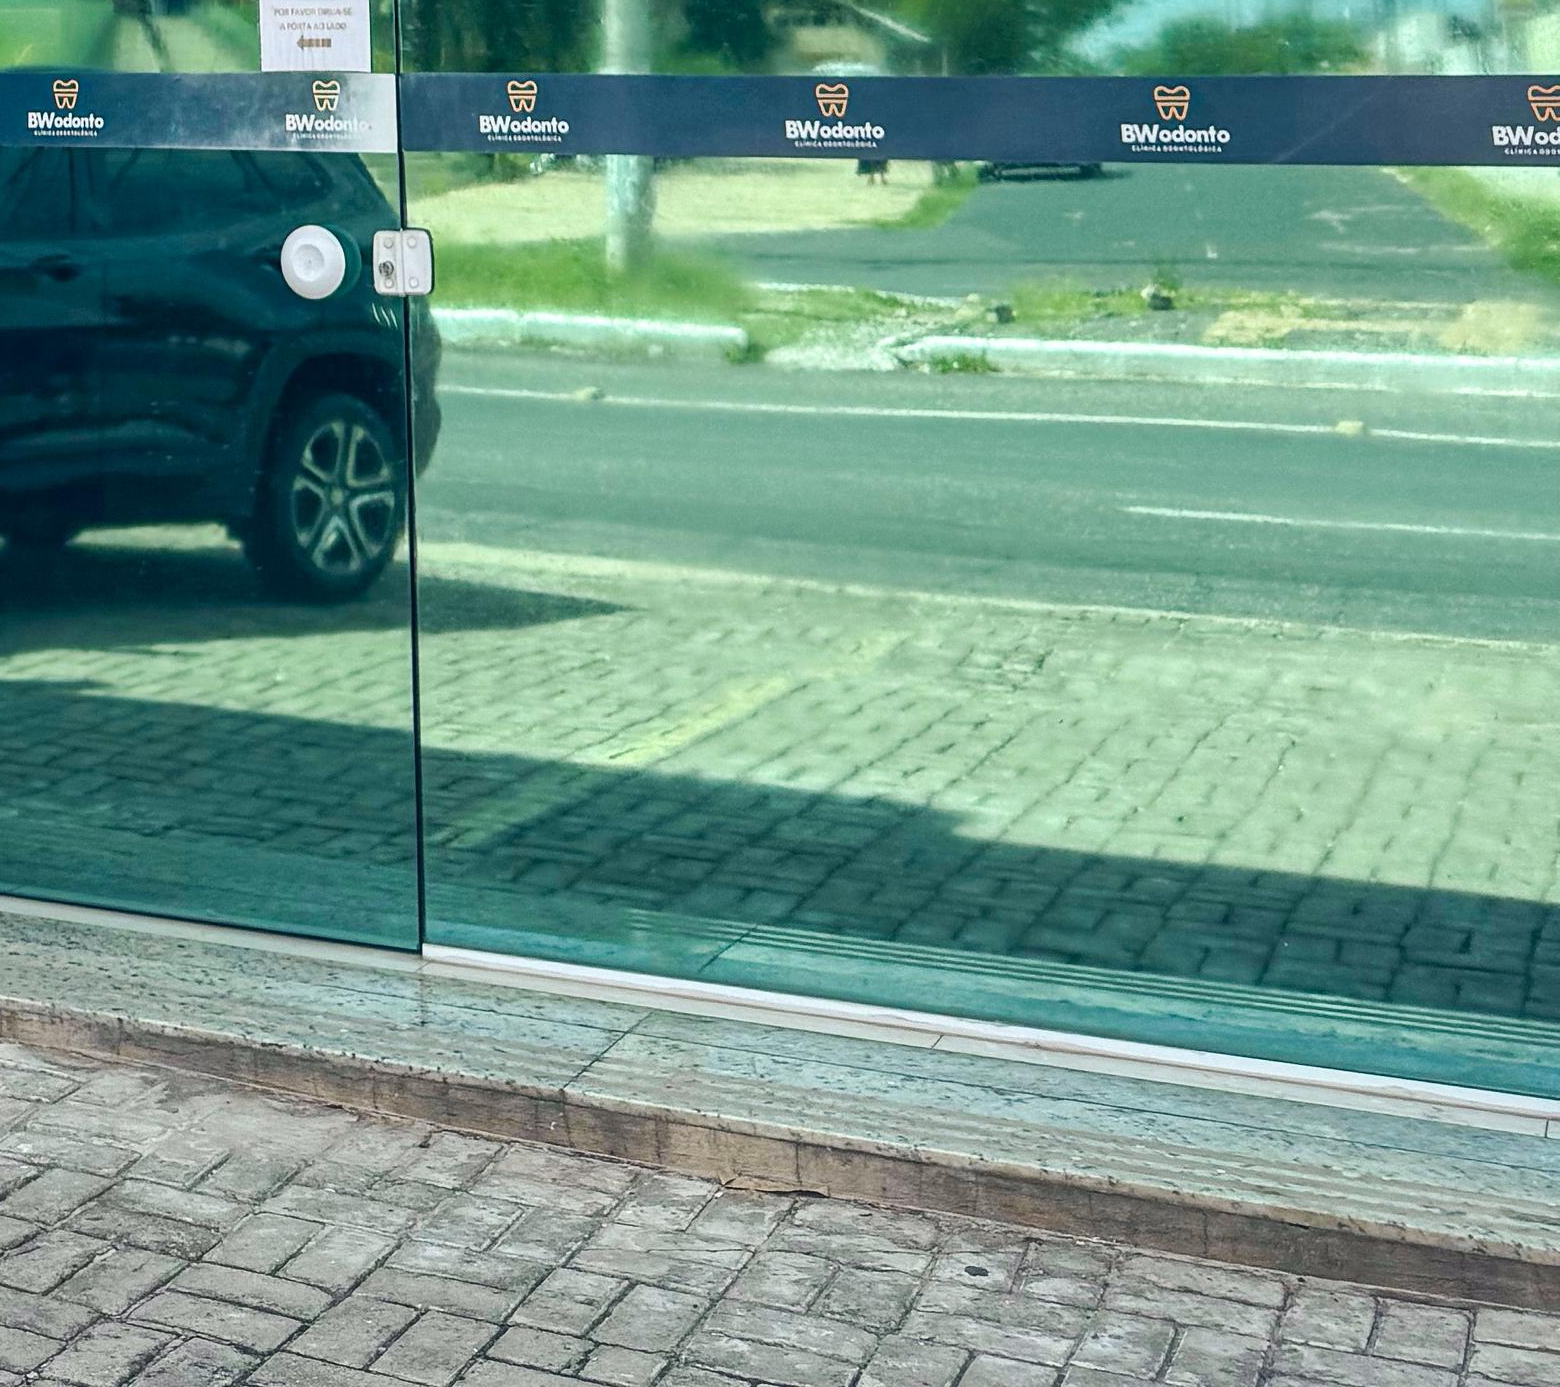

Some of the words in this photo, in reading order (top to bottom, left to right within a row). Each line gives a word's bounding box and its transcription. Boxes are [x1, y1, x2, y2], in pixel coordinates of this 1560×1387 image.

[28, 111, 105, 129] BWodonto
[479, 115, 570, 134] BWodonto
[785, 120, 885, 140] BWodonto
[1120, 123, 1231, 144] BWodonto
